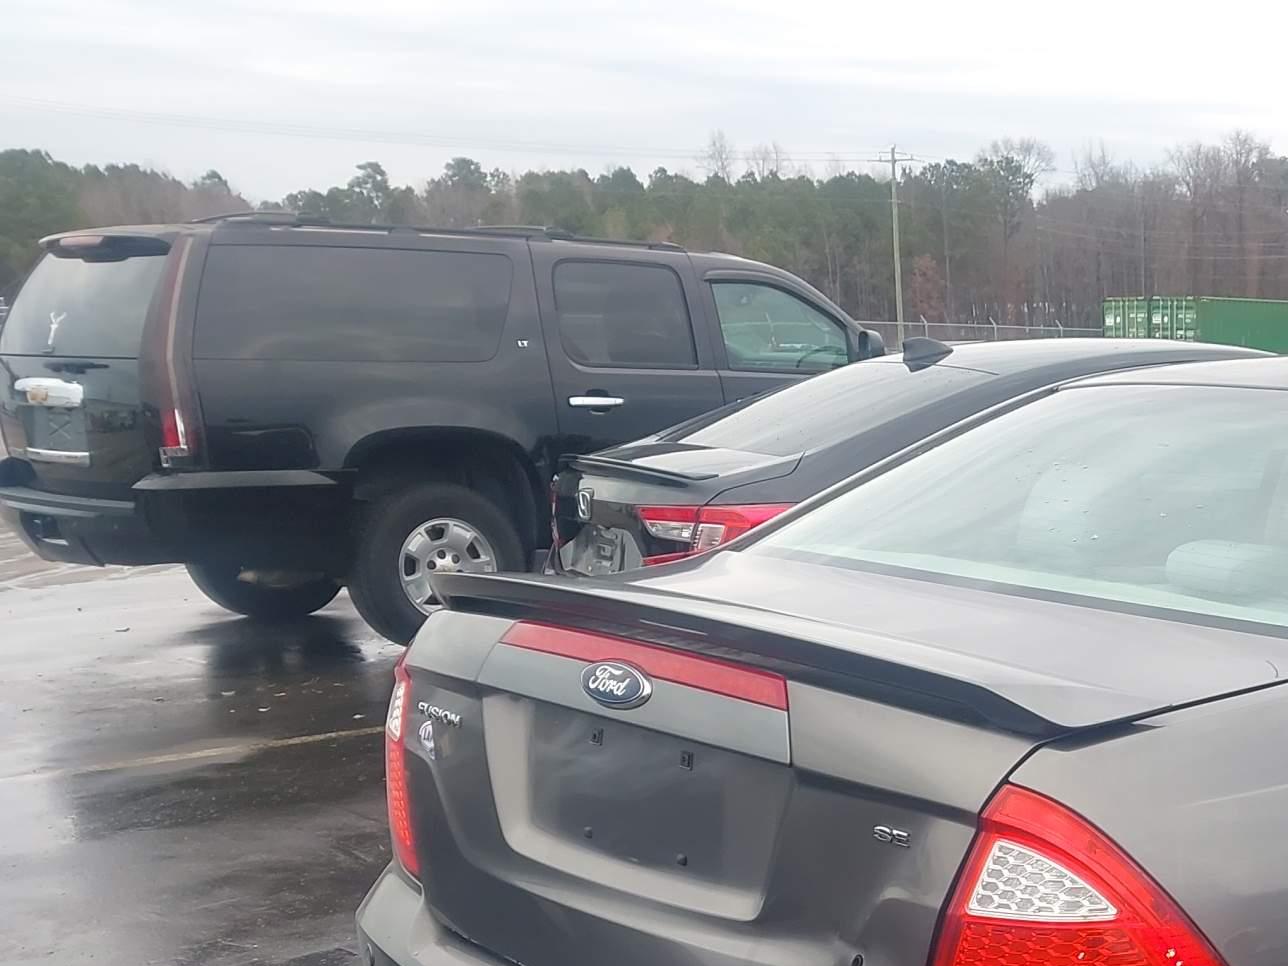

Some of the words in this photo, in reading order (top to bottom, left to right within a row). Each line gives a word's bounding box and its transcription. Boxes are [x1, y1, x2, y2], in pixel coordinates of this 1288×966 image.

[588, 665, 631, 696] Ford
[418, 701, 462, 726] FUSION
[873, 825, 909, 847] SE
